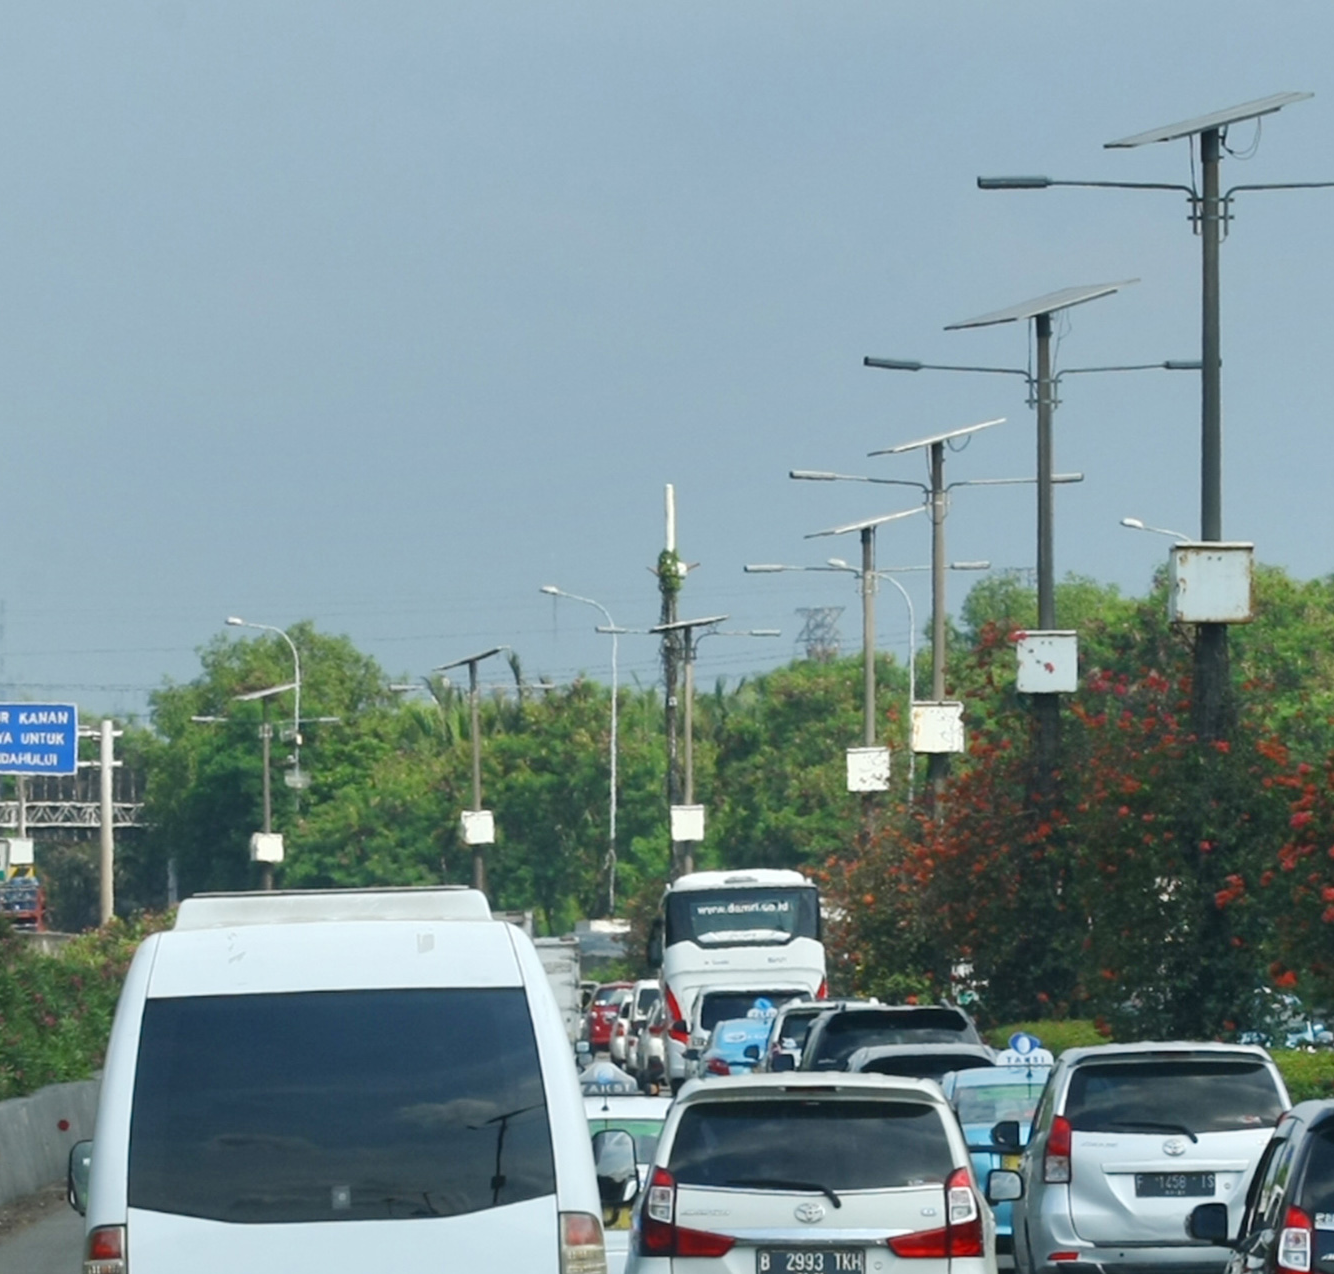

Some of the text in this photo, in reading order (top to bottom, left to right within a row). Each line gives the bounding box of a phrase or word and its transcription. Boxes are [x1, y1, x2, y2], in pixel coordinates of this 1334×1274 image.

[18, 711, 68, 725] KANAN
[20, 732, 65, 745] UNTUK
[760, 1253, 862, 1271] B 2993 TKH
